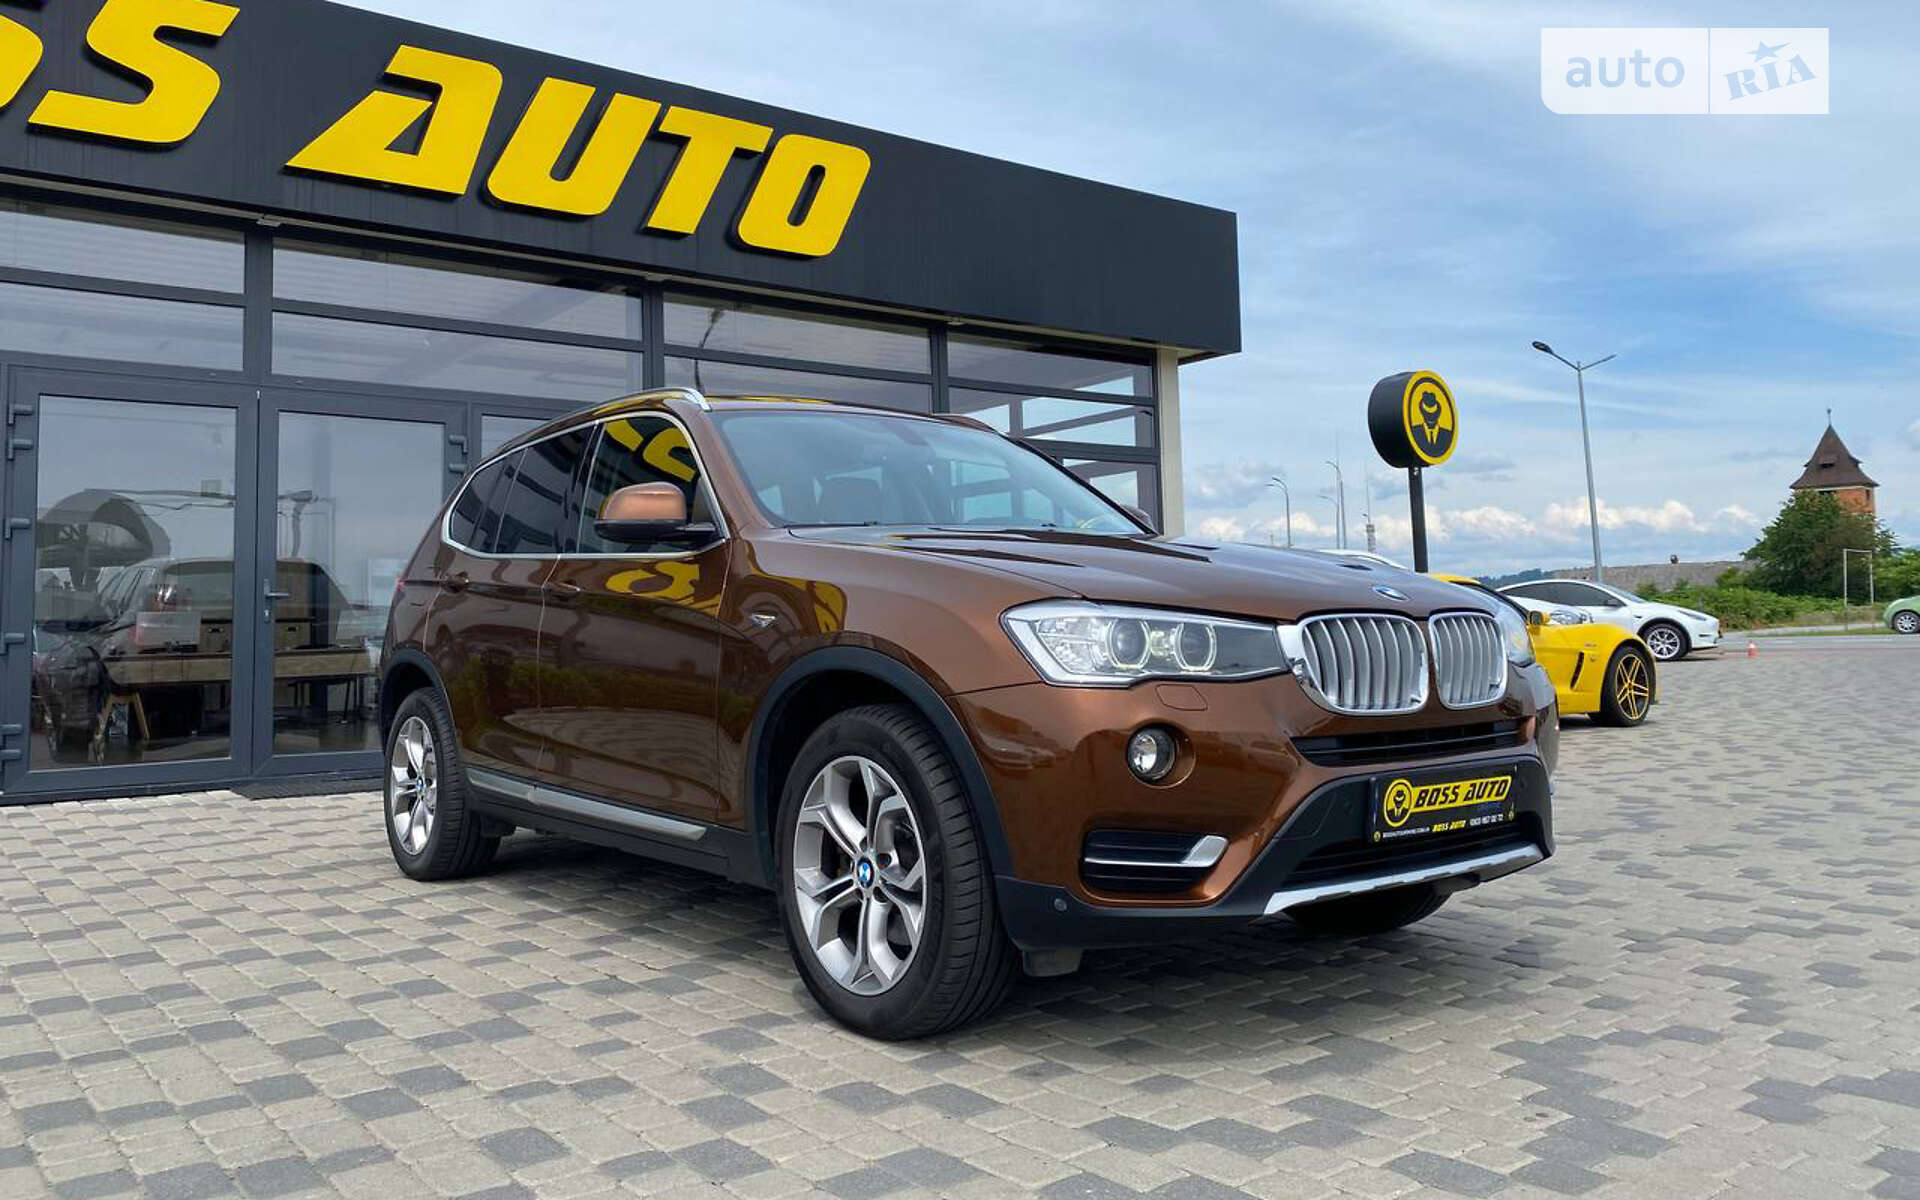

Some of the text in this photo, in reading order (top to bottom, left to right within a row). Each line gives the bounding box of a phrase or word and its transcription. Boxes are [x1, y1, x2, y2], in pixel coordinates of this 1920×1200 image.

[0, 0, 871, 257] S AUTO
[1415, 780, 1509, 807] BOSS AUTO
